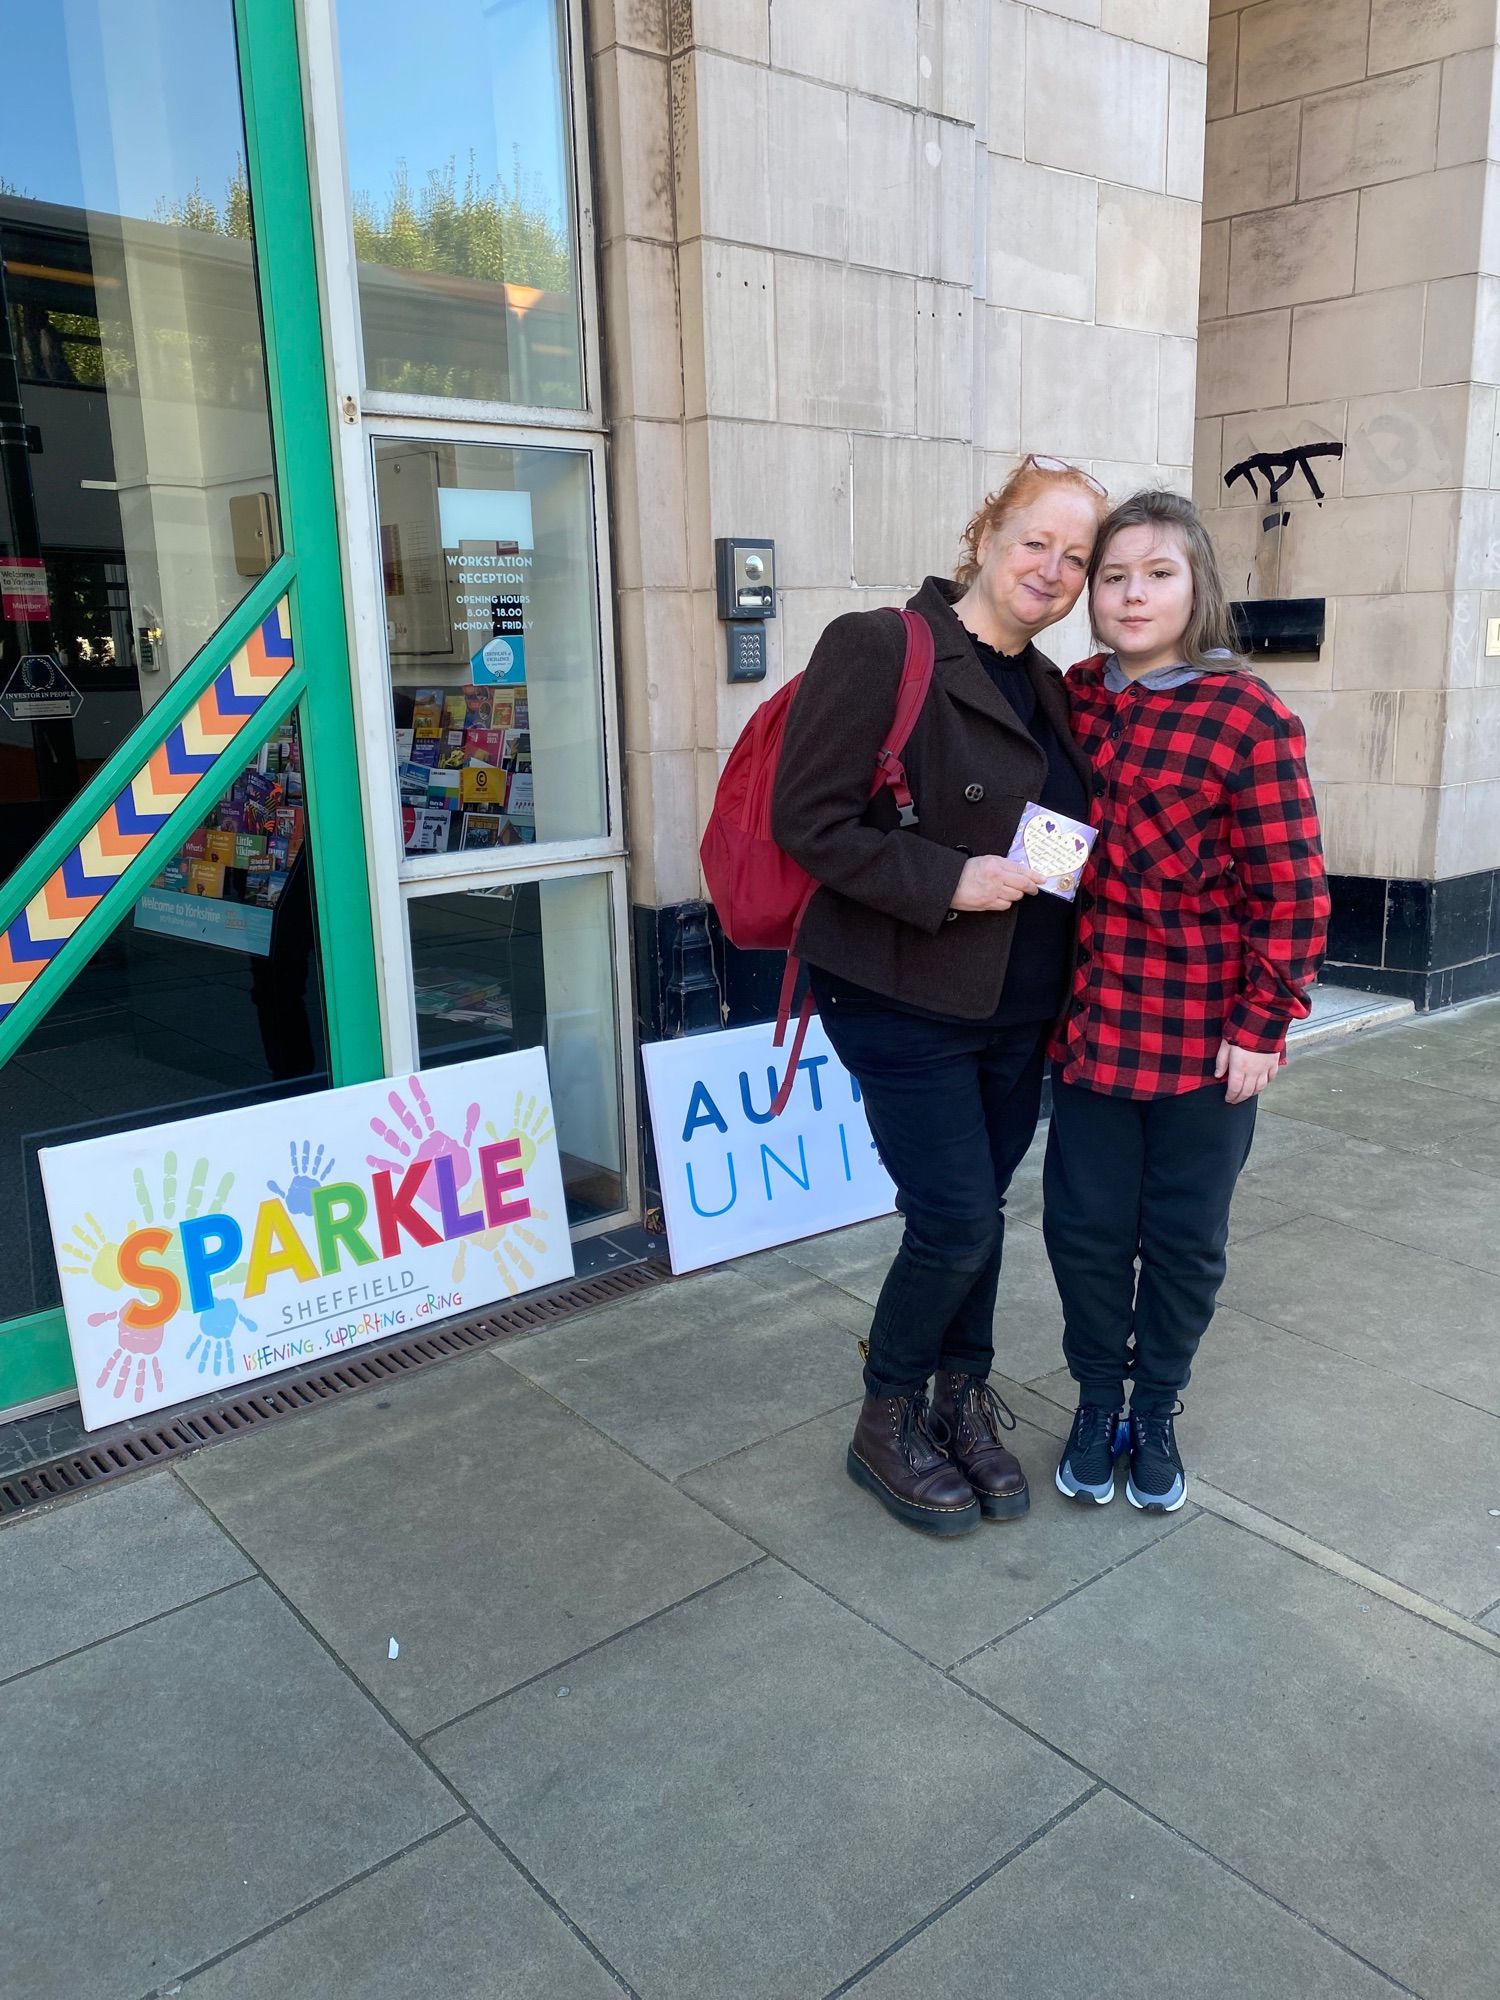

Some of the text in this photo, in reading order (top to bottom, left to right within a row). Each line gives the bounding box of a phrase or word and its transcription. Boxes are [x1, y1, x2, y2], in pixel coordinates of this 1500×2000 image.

[446, 555, 533, 567] WORKSTATION
[1, 570, 36, 579] Welcome
[459, 573, 524, 584] RECEPTION
[12, 579, 46, 587] Yorkshire
[456, 594, 530, 604] OPENING HOURS
[12, 602, 42, 610] Member
[467, 608, 490, 617] 8.00
[496, 608, 522, 617] 18.00
[453, 621, 495, 631] MONDAY
[502, 620, 534, 630] FRIDAY
[6, 691, 41, 699] INVESTOR
[50, 690, 76, 698] PEOPLE
[236, 835, 253, 847] Little
[185, 842, 204, 853] What's
[141, 895, 175, 914] Welcome
[176, 903, 184, 916] to
[184, 903, 221, 924] Yorkshire
[116, 1137, 532, 1329] SPARKLE
[281, 1270, 415, 1325] SHEFFIELD
